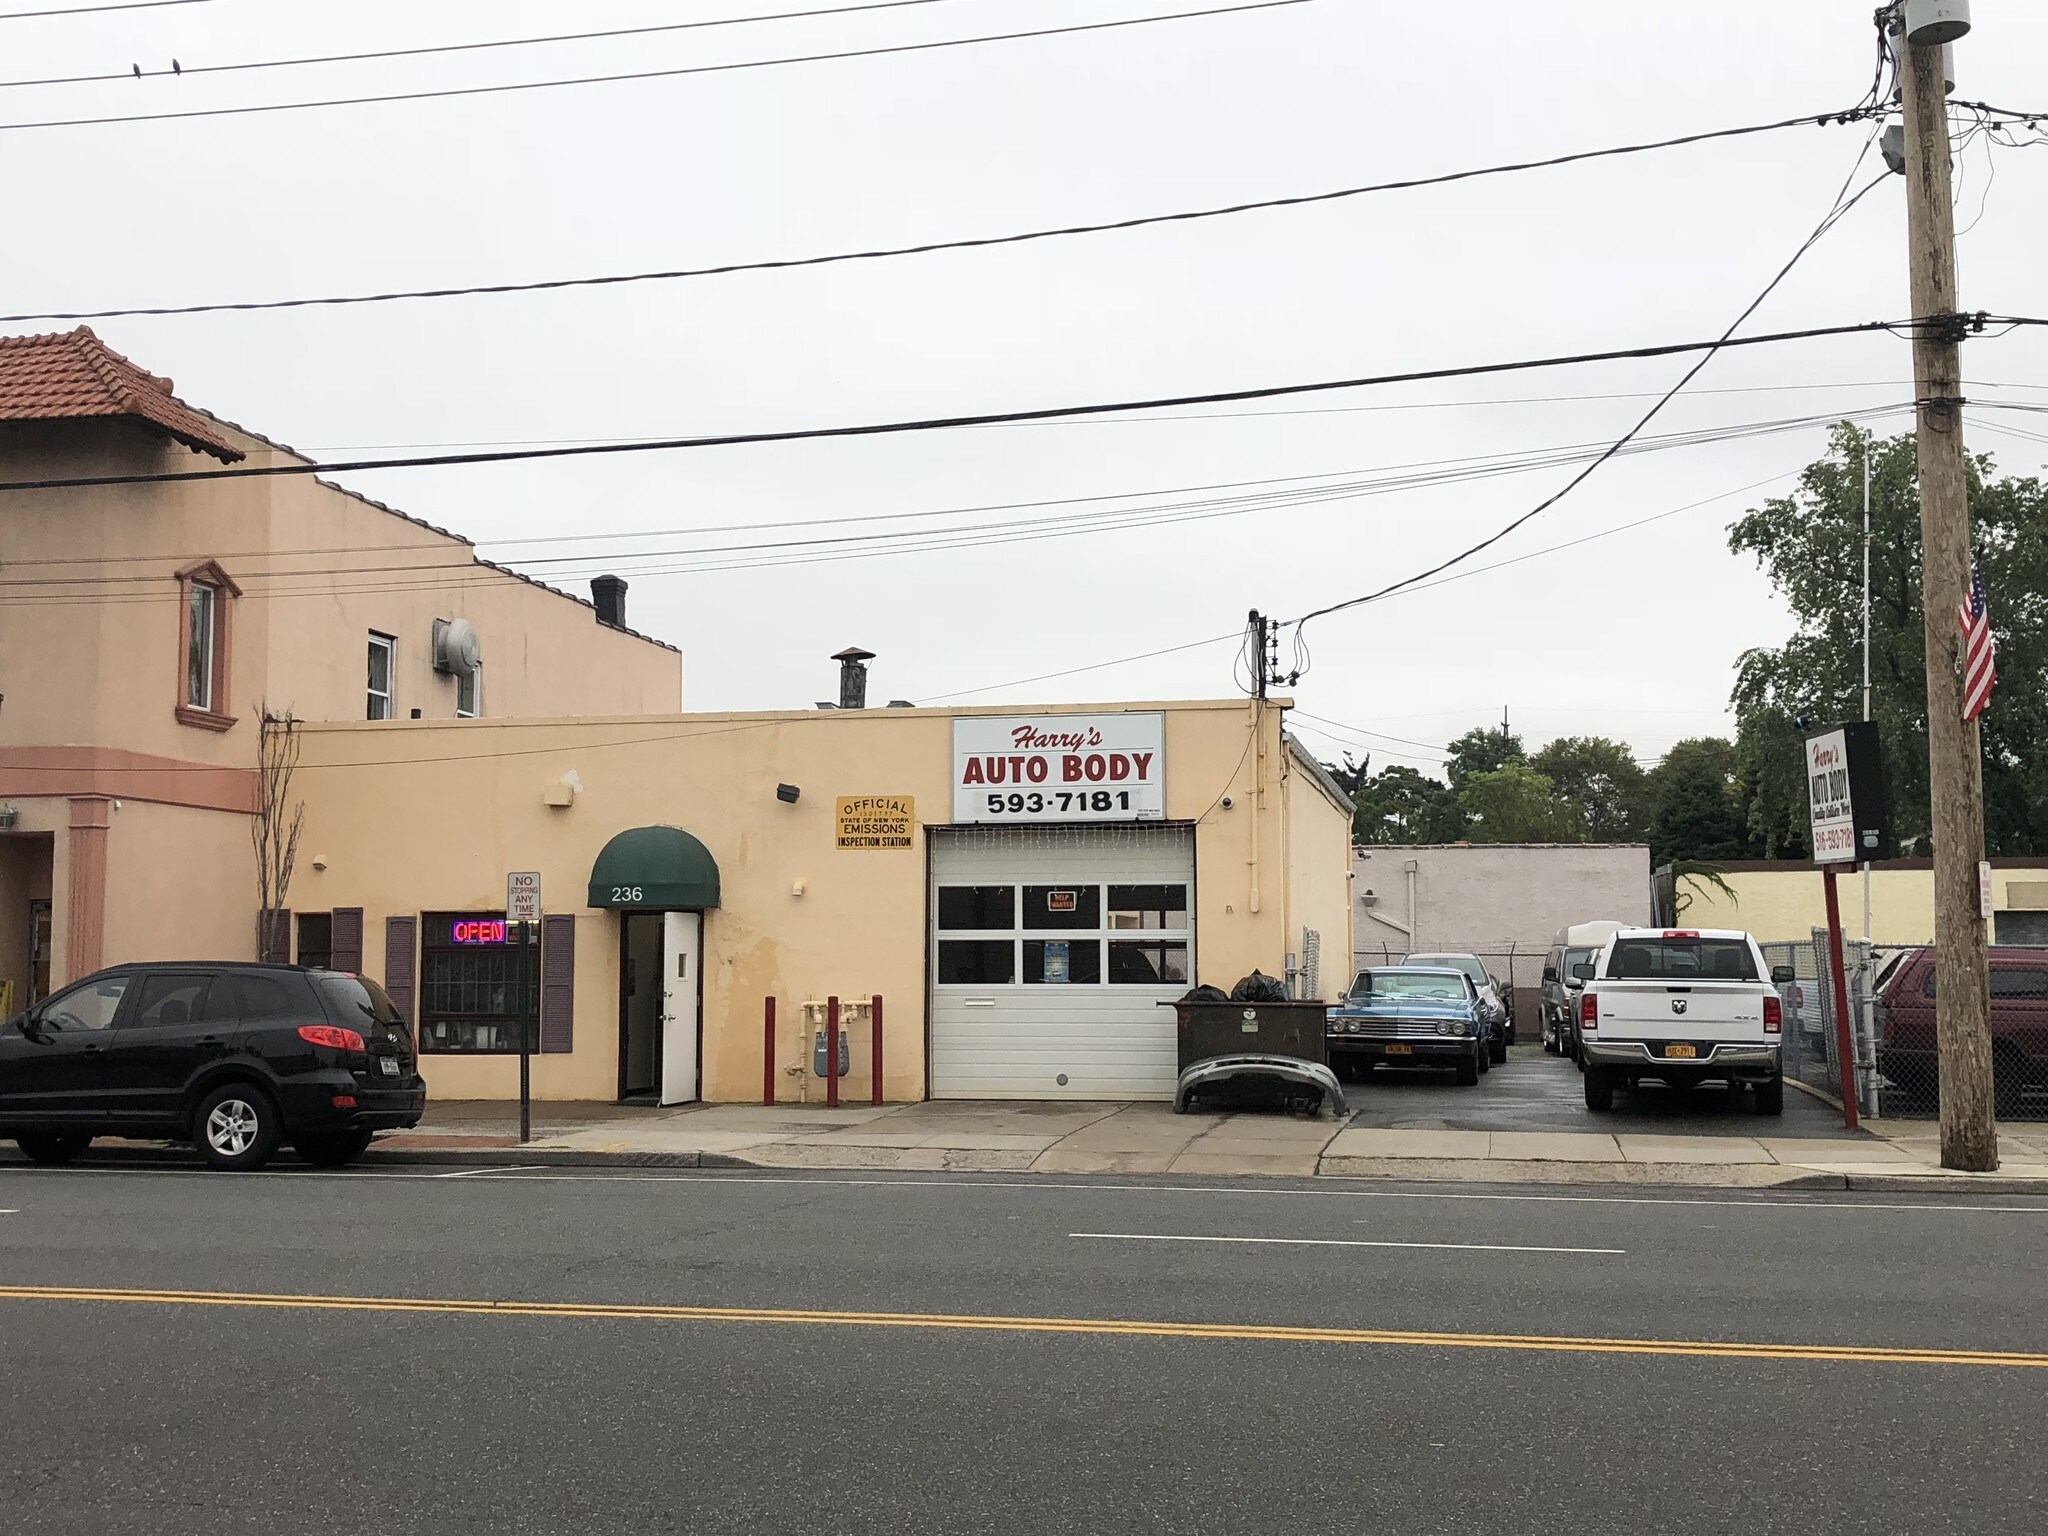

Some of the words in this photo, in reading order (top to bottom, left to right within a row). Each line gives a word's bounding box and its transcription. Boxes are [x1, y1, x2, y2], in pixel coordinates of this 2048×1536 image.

[1011, 725, 1103, 752] Harry's
[962, 755, 1048, 784] AUTO
[1062, 753, 1153, 782] BODY
[1812, 773, 1829, 805] AUTO
[1829, 768, 1848, 801] BODY
[844, 799, 908, 814] OFFICIAL
[988, 791, 1129, 813] 593-7181
[844, 824, 905, 834] EMISSIONS
[838, 837, 880, 847] INSPECTION
[882, 837, 911, 847] STATION
[515, 876, 533, 886] NO
[510, 887, 538, 895] STOPPING
[612, 887, 643, 902] 236
[515, 895, 533, 903] ANY
[514, 905, 535, 913] TIME
[454, 921, 504, 942] OPEN
